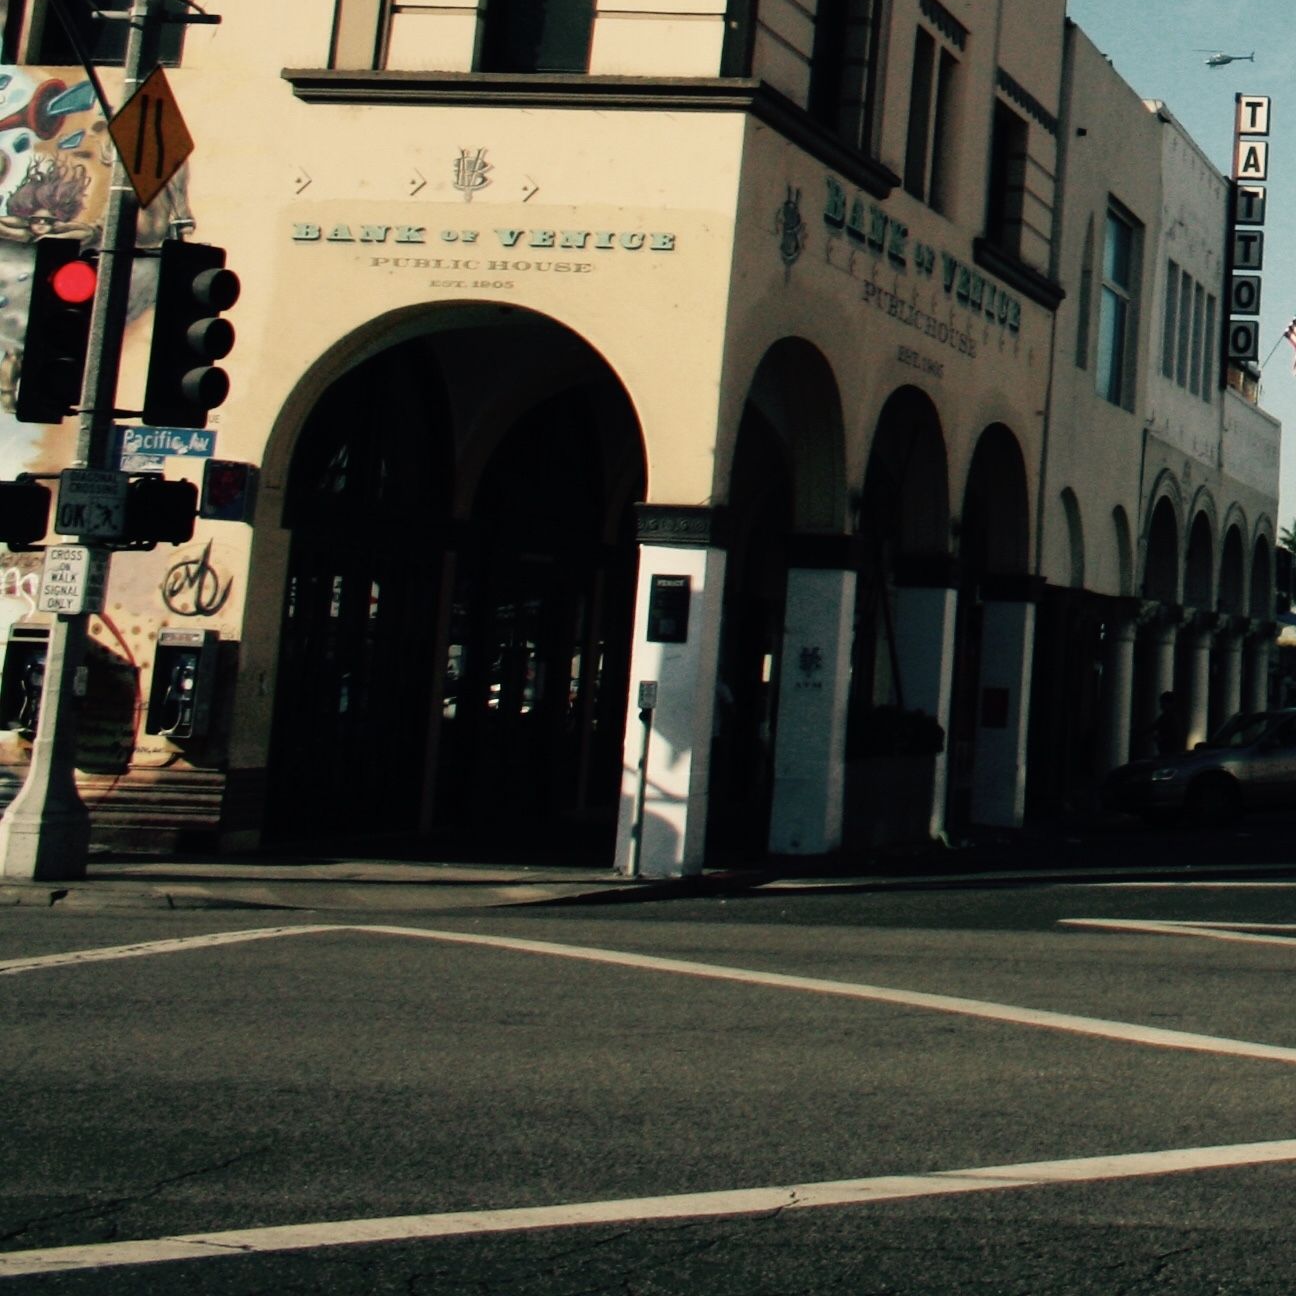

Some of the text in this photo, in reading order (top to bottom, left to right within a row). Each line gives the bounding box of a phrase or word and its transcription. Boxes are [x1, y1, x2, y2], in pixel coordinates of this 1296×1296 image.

[291, 222, 426, 244] BANK
[494, 228, 677, 251] VENICE
[1230, 101, 1264, 353] TATTOO
[824, 175, 909, 269] BANK
[942, 249, 1022, 333] VENICE
[369, 256, 592, 274] PUBLIC HOUSE
[923, 317, 977, 359] HOUSE
[123, 428, 183, 451] Pacific
[61, 503, 85, 528] OK
[50, 549, 83, 561] CROSS
[57, 562, 71, 572] ON
[51, 571, 77, 584] WALK
[44, 584, 79, 597] SIGNAL
[47, 597, 74, 609] ONLY
